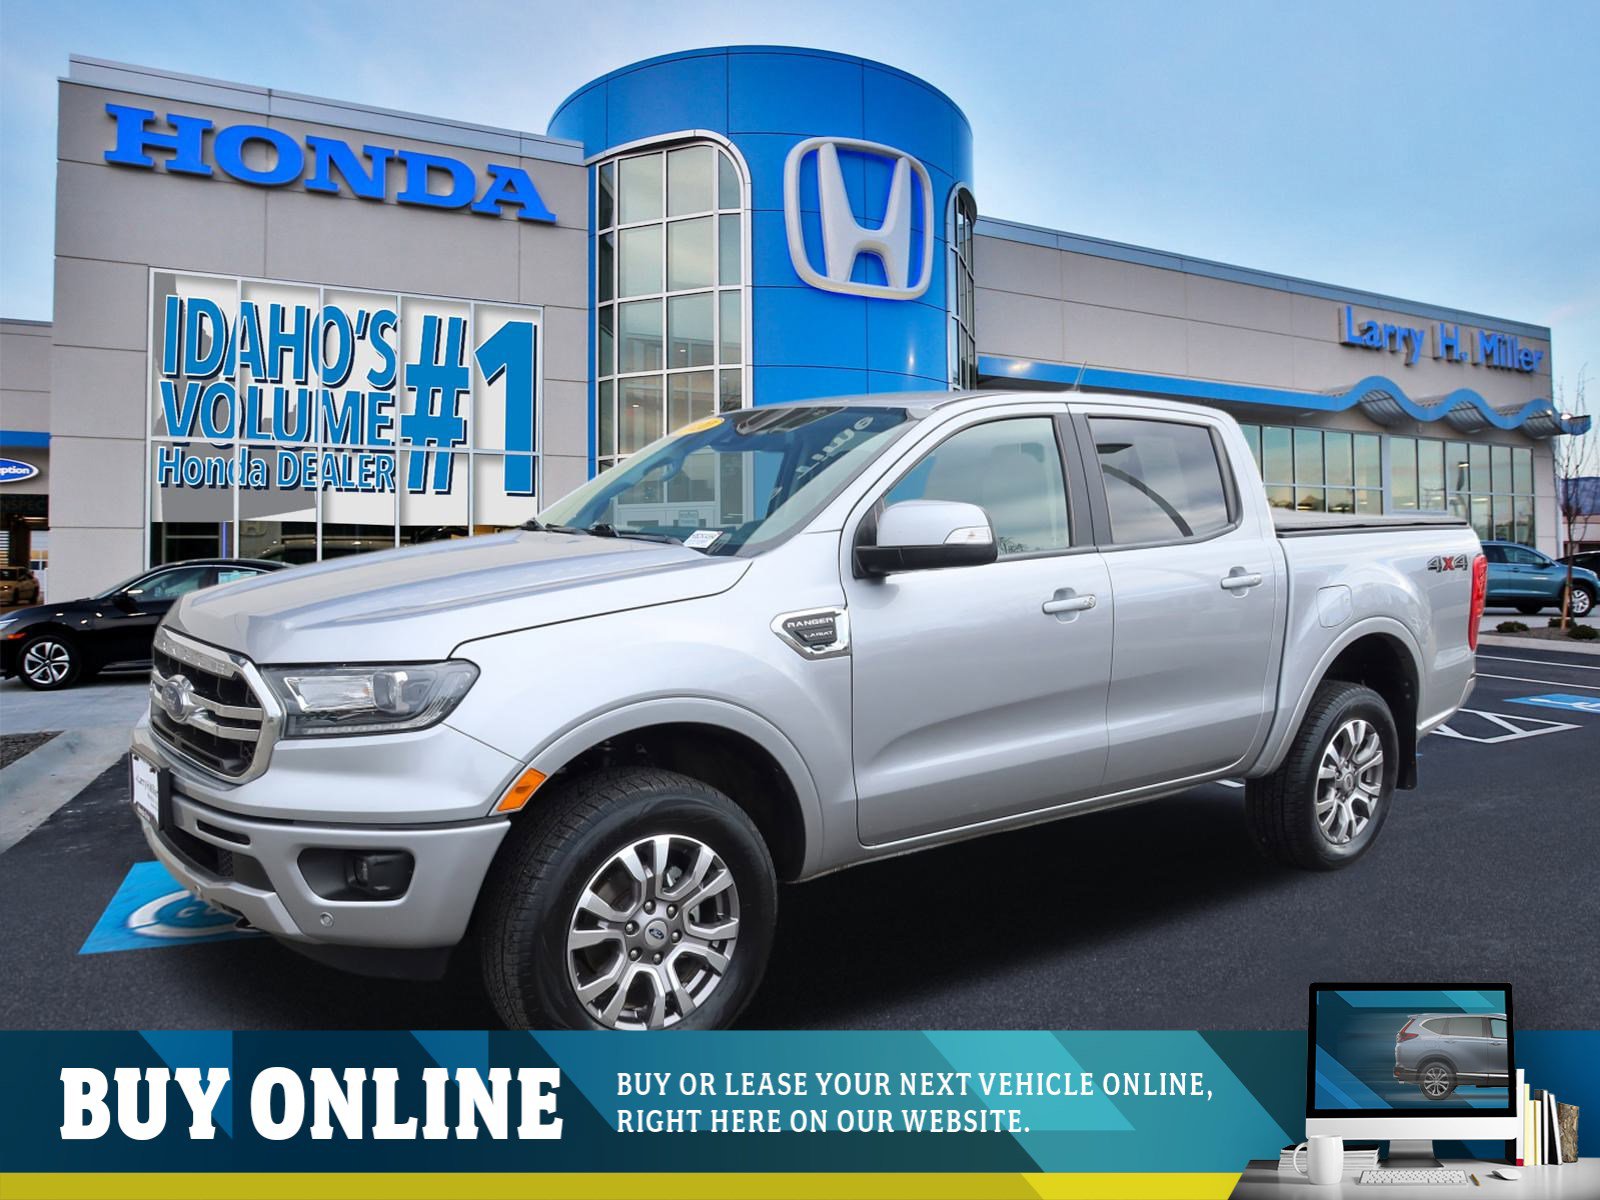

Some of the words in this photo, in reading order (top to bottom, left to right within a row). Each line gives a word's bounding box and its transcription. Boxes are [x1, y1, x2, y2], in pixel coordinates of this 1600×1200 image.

[104, 103, 557, 224] HONDA
[162, 294, 399, 389] IDAHO'S
[1340, 306, 1425, 365] Larry
[1434, 323, 1467, 362] H.
[1473, 330, 1545, 373] Miller
[159, 381, 396, 449] VOLUME
[400, 315, 538, 497] #1
[157, 446, 268, 490] Honda
[276, 452, 397, 493] DEALER
[786, 616, 835, 629] RANGER
